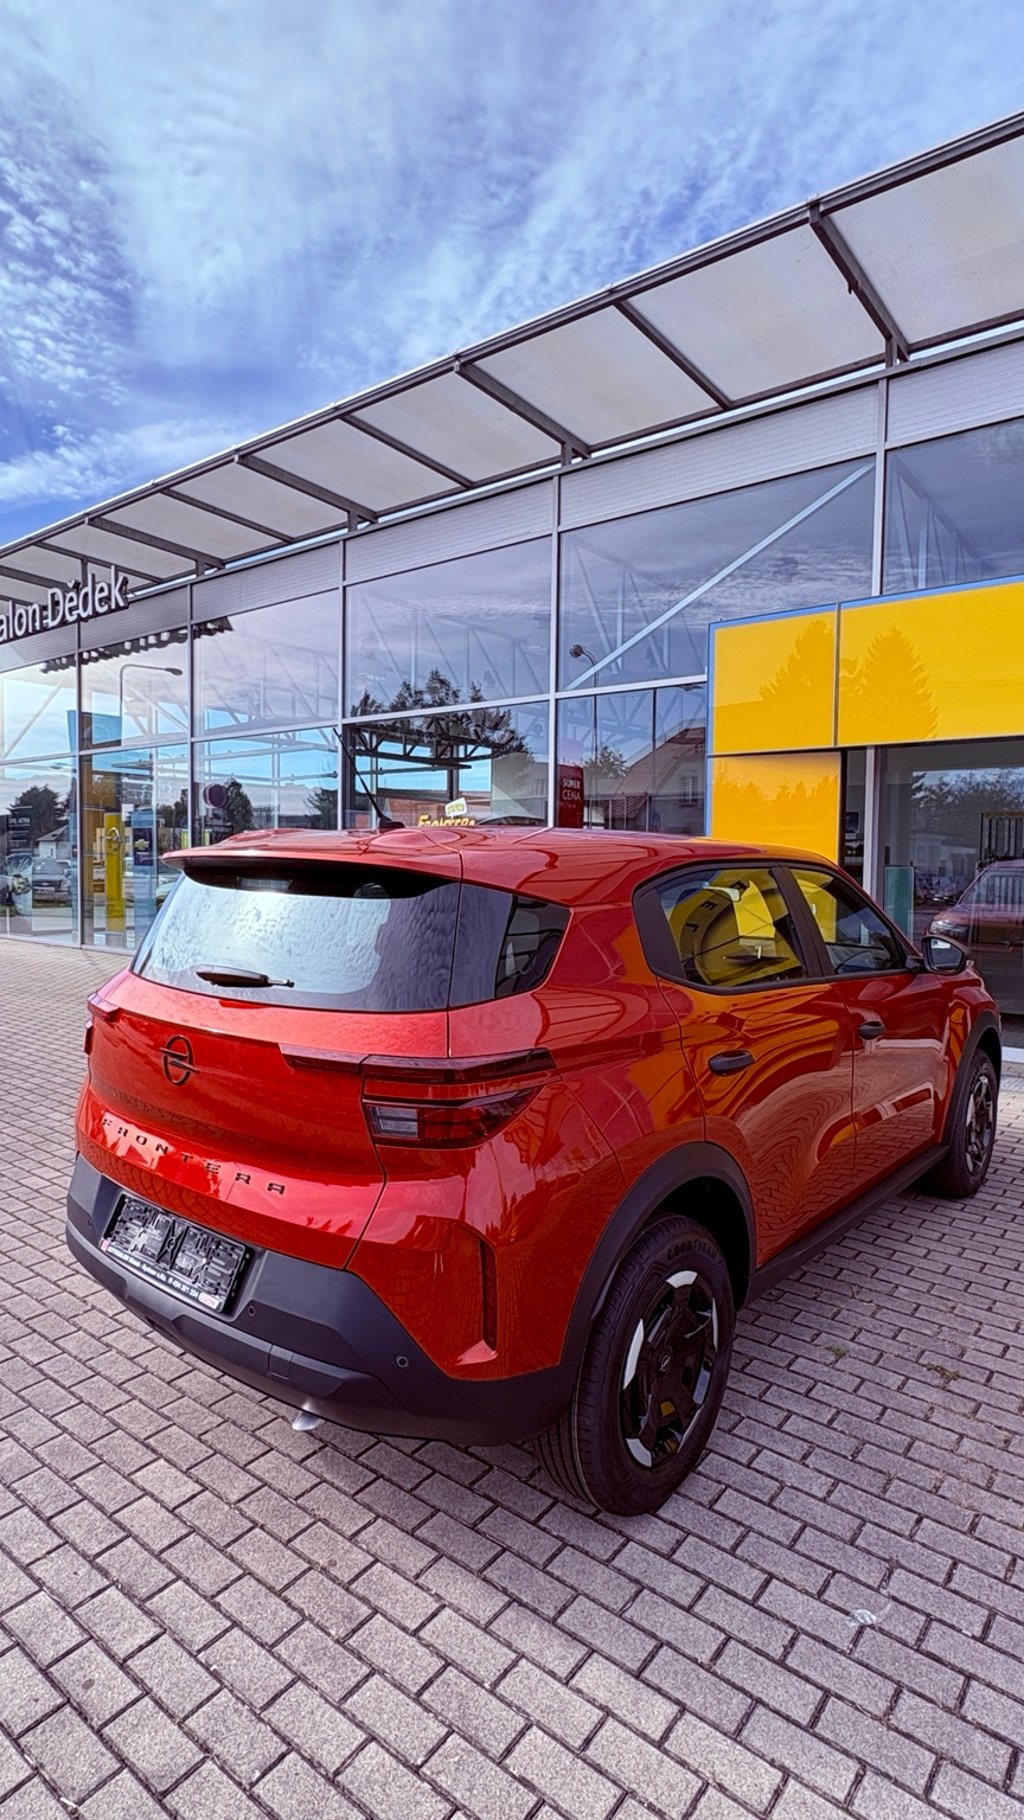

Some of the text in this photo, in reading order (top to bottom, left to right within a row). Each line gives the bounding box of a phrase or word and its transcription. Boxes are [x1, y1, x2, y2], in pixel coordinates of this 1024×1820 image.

[48, 565, 126, 628] Dědek
[562, 789, 581, 800] CENA
[102, 1118, 285, 1195] FRONTERA
